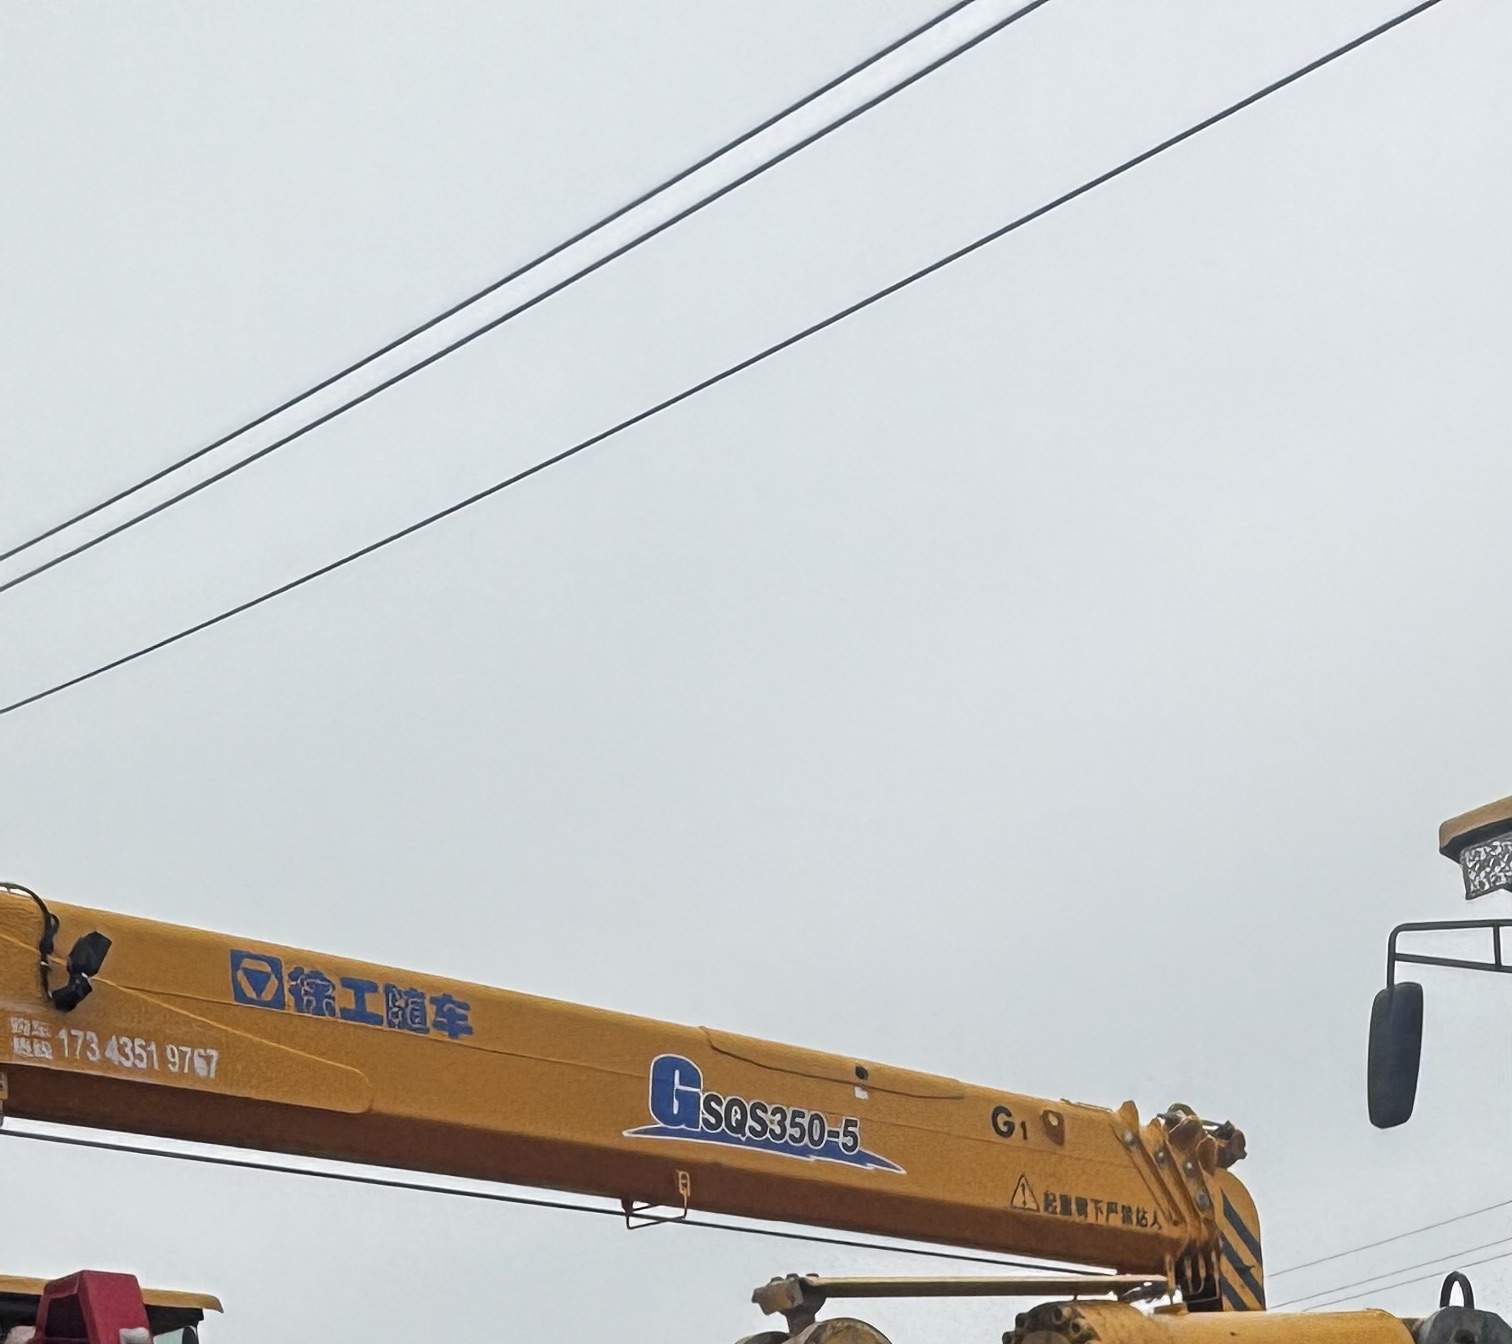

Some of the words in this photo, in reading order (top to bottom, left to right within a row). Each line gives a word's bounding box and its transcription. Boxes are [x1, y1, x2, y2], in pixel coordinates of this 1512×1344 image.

[286, 966, 474, 1040] 徐工随车
[58, 1027, 100, 1062] 173
[105, 1034, 160, 1071] 4351
[166, 1043, 219, 1079] 9767
[991, 1105, 1028, 1141] G1
